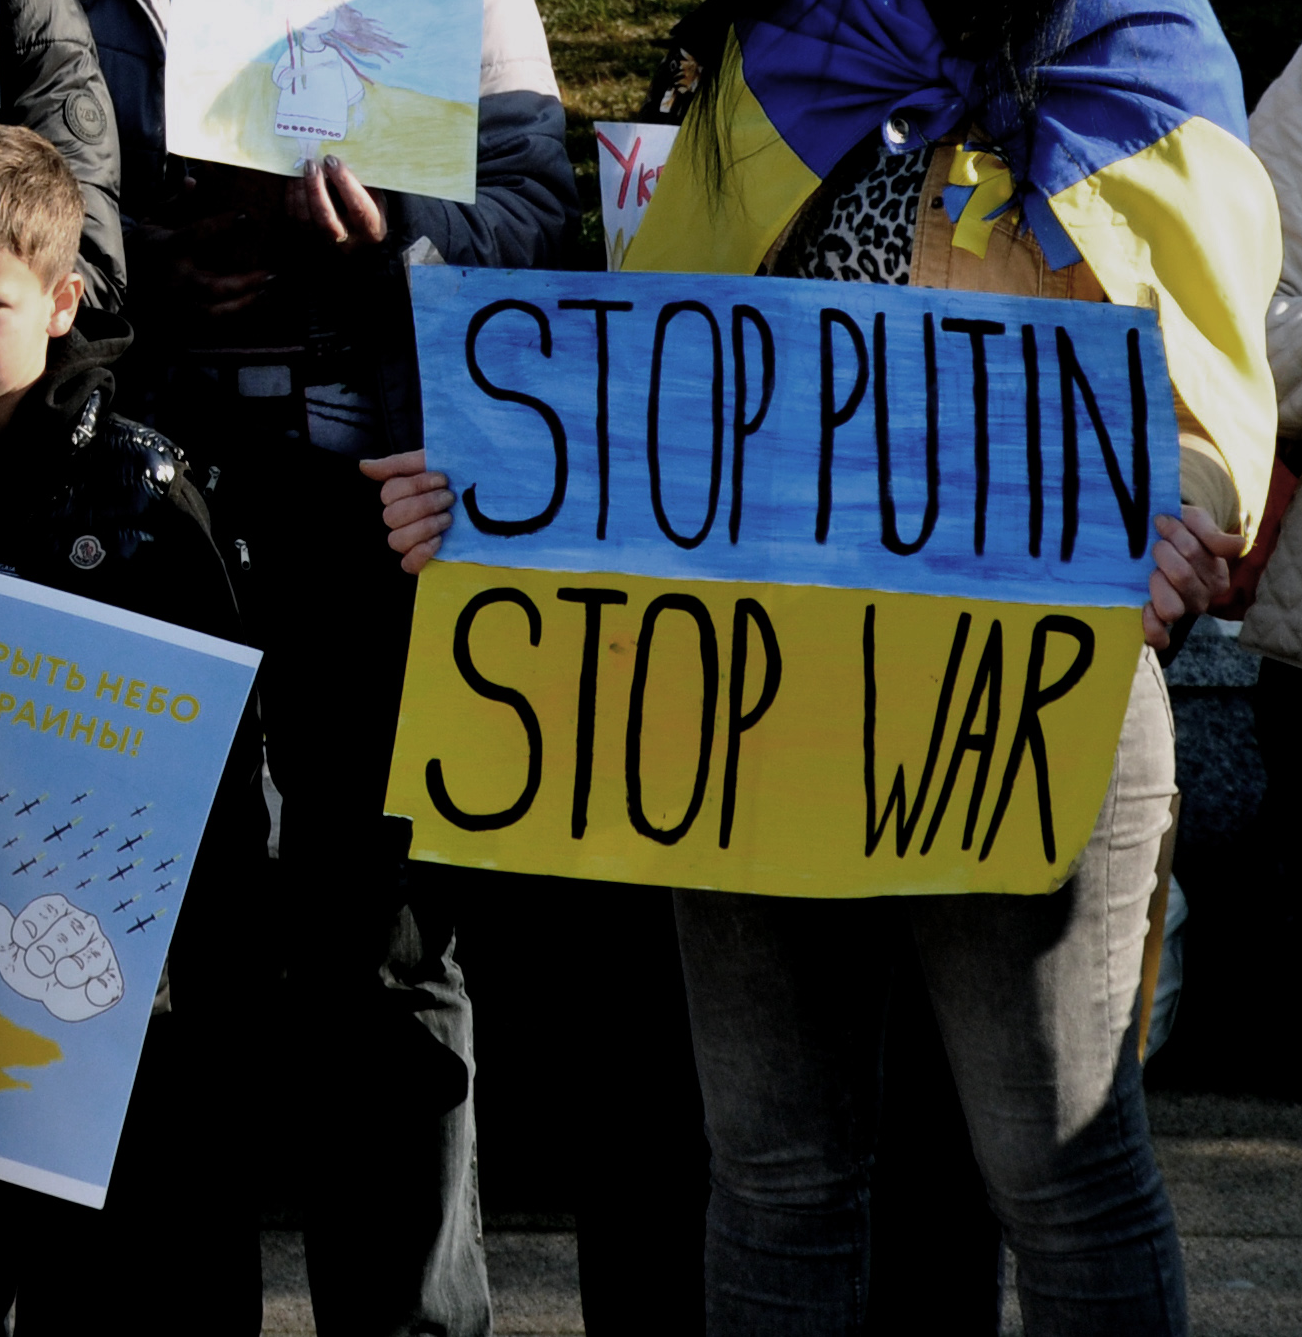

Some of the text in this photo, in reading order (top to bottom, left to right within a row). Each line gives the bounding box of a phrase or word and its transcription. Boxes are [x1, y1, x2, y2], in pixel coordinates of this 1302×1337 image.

[462, 298, 1151, 563] STOP PUTIN
[97, 669, 200, 723] НЕБО
[425, 586, 1096, 865] STOP WAR
